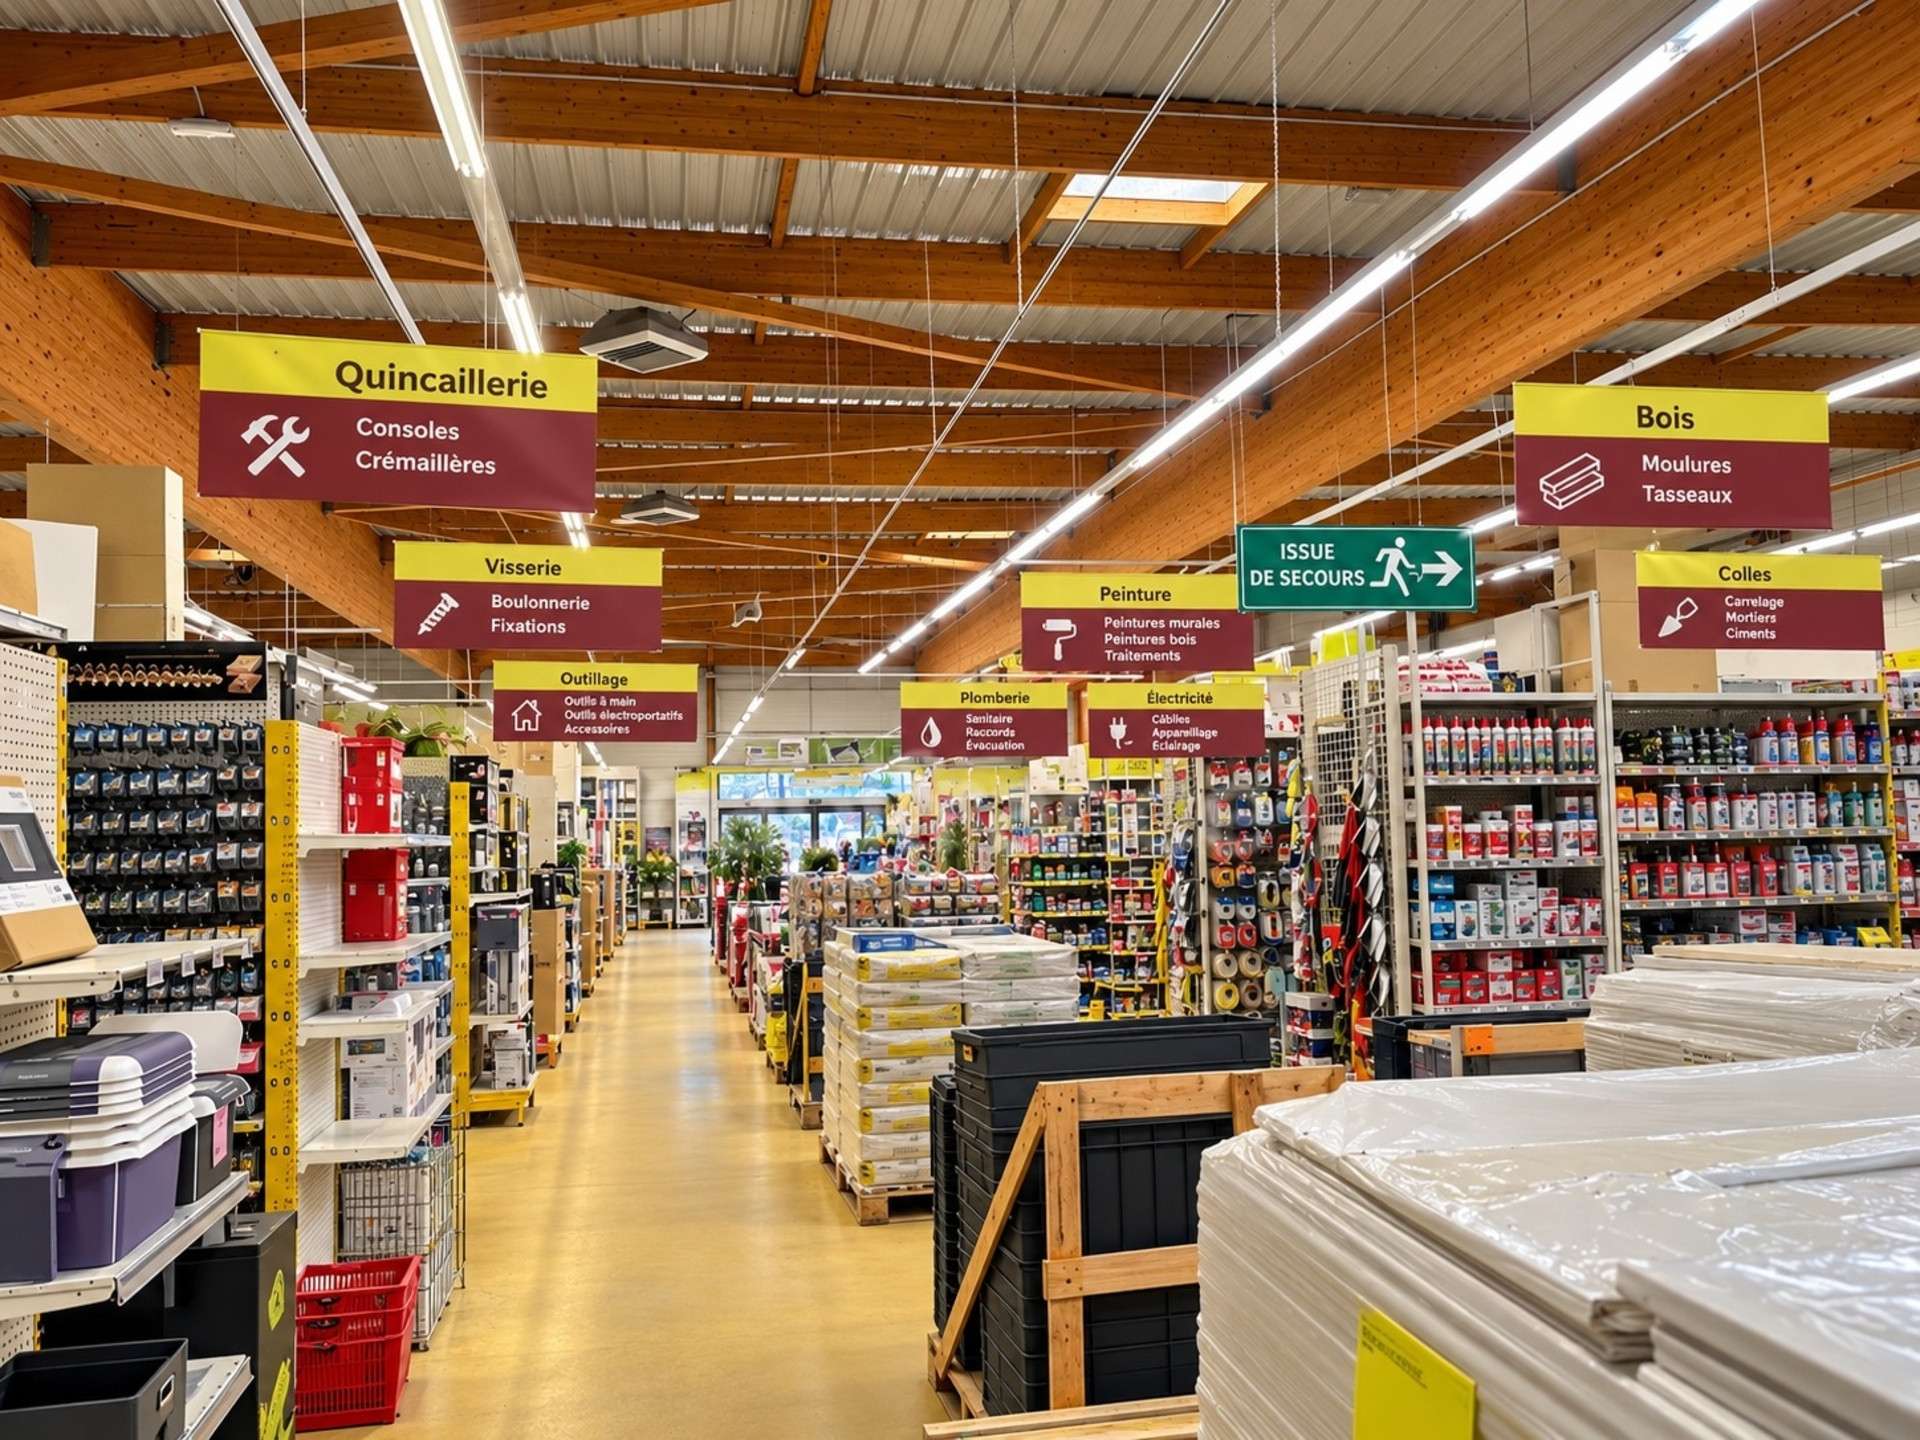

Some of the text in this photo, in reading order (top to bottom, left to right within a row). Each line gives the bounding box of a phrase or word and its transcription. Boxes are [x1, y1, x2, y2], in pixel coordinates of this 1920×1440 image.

[335, 360, 549, 400] Quincaillerie
[1636, 404, 1695, 431] Bois
[356, 417, 460, 441] Consoles
[355, 450, 496, 475] Crémaillères
[1642, 454, 1732, 474] Moulures
[1641, 484, 1733, 504] Tasseaux
[1280, 542, 1335, 561] ISSUE
[484, 557, 562, 577] Visserie
[1718, 565, 1772, 582] Colles
[1250, 569, 1365, 587] DE SECOURS
[491, 593, 591, 611] Boulonnerie
[1100, 585, 1172, 602] Peinture
[1724, 594, 1785, 611] Carrelage
[491, 617, 566, 634] Fixations
[1104, 615, 1221, 630] Peintures murales
[1725, 610, 1777, 624] Mortiers
[1104, 631, 1197, 646] Peintures bois
[1725, 626, 1777, 640] Ciments
[1104, 648, 1181, 662] Traitements
[560, 671, 629, 690] Outillage
[563, 695, 637, 707] Outils à main
[960, 691, 1030, 704] Plomberie
[1147, 689, 1214, 705] Électricité
[564, 708, 684, 723] Outils électroportatifs
[965, 712, 1014, 724] Sanitaire
[564, 722, 631, 735] Accessoires
[965, 726, 1016, 738] Raccords
[1151, 726, 1219, 740] Appareillage
[965, 738, 1025, 751] Évacuation
